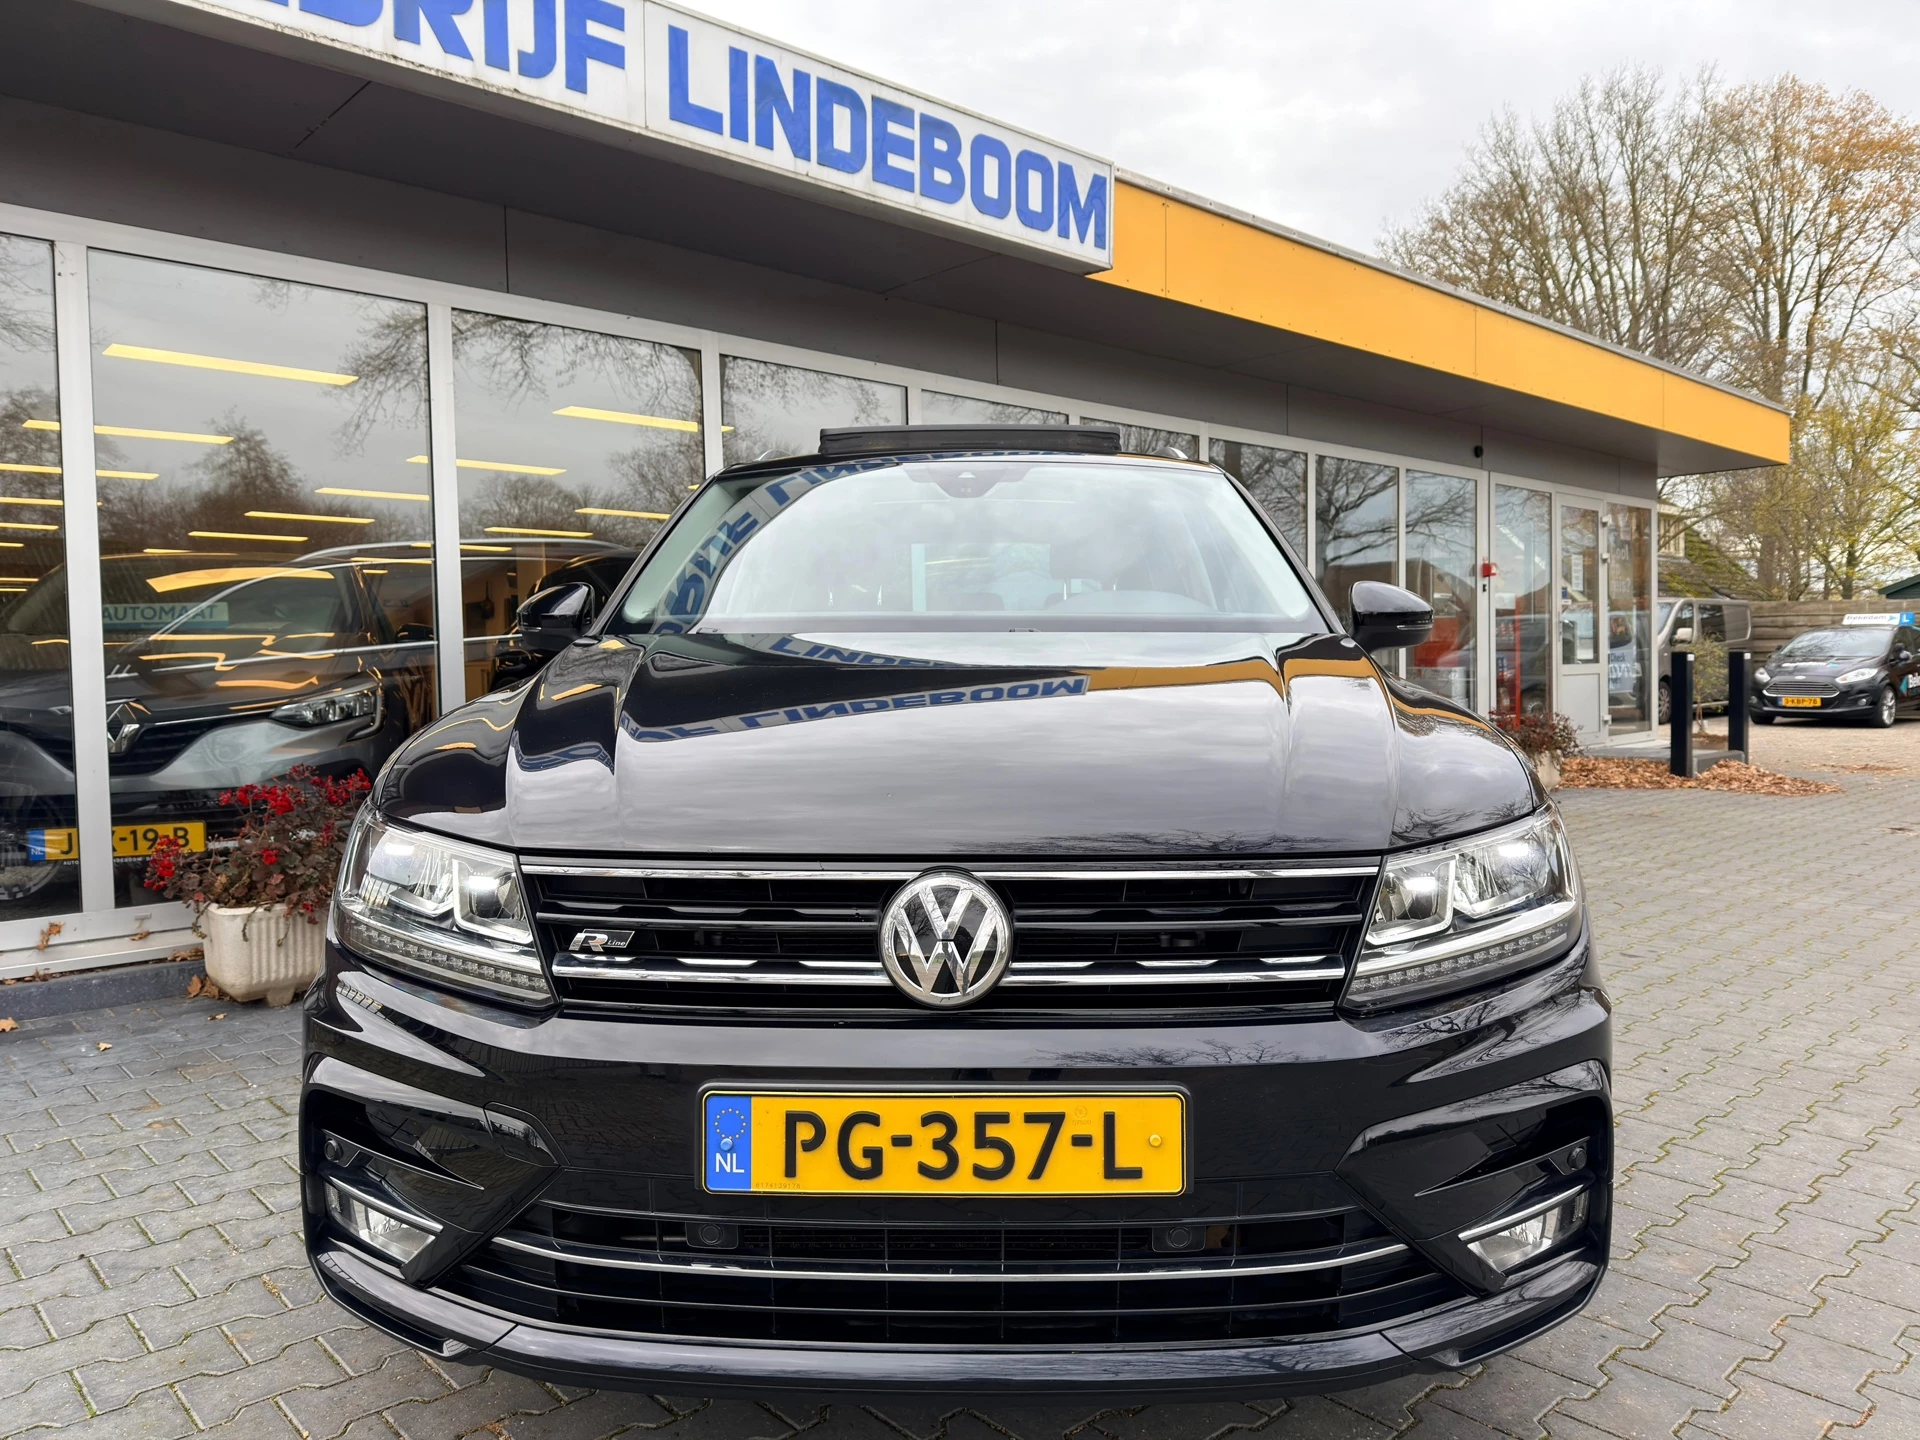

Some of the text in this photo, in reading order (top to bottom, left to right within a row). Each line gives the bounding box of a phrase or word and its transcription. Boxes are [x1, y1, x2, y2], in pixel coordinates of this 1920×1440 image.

[668, 24, 1107, 250] LINDEBOOM
[102, 605, 218, 621] AUTOMAAT
[1903, 613, 1910, 622] L
[569, 933, 626, 952] R Line
[714, 1110, 1143, 1180] NL PG-357-L
